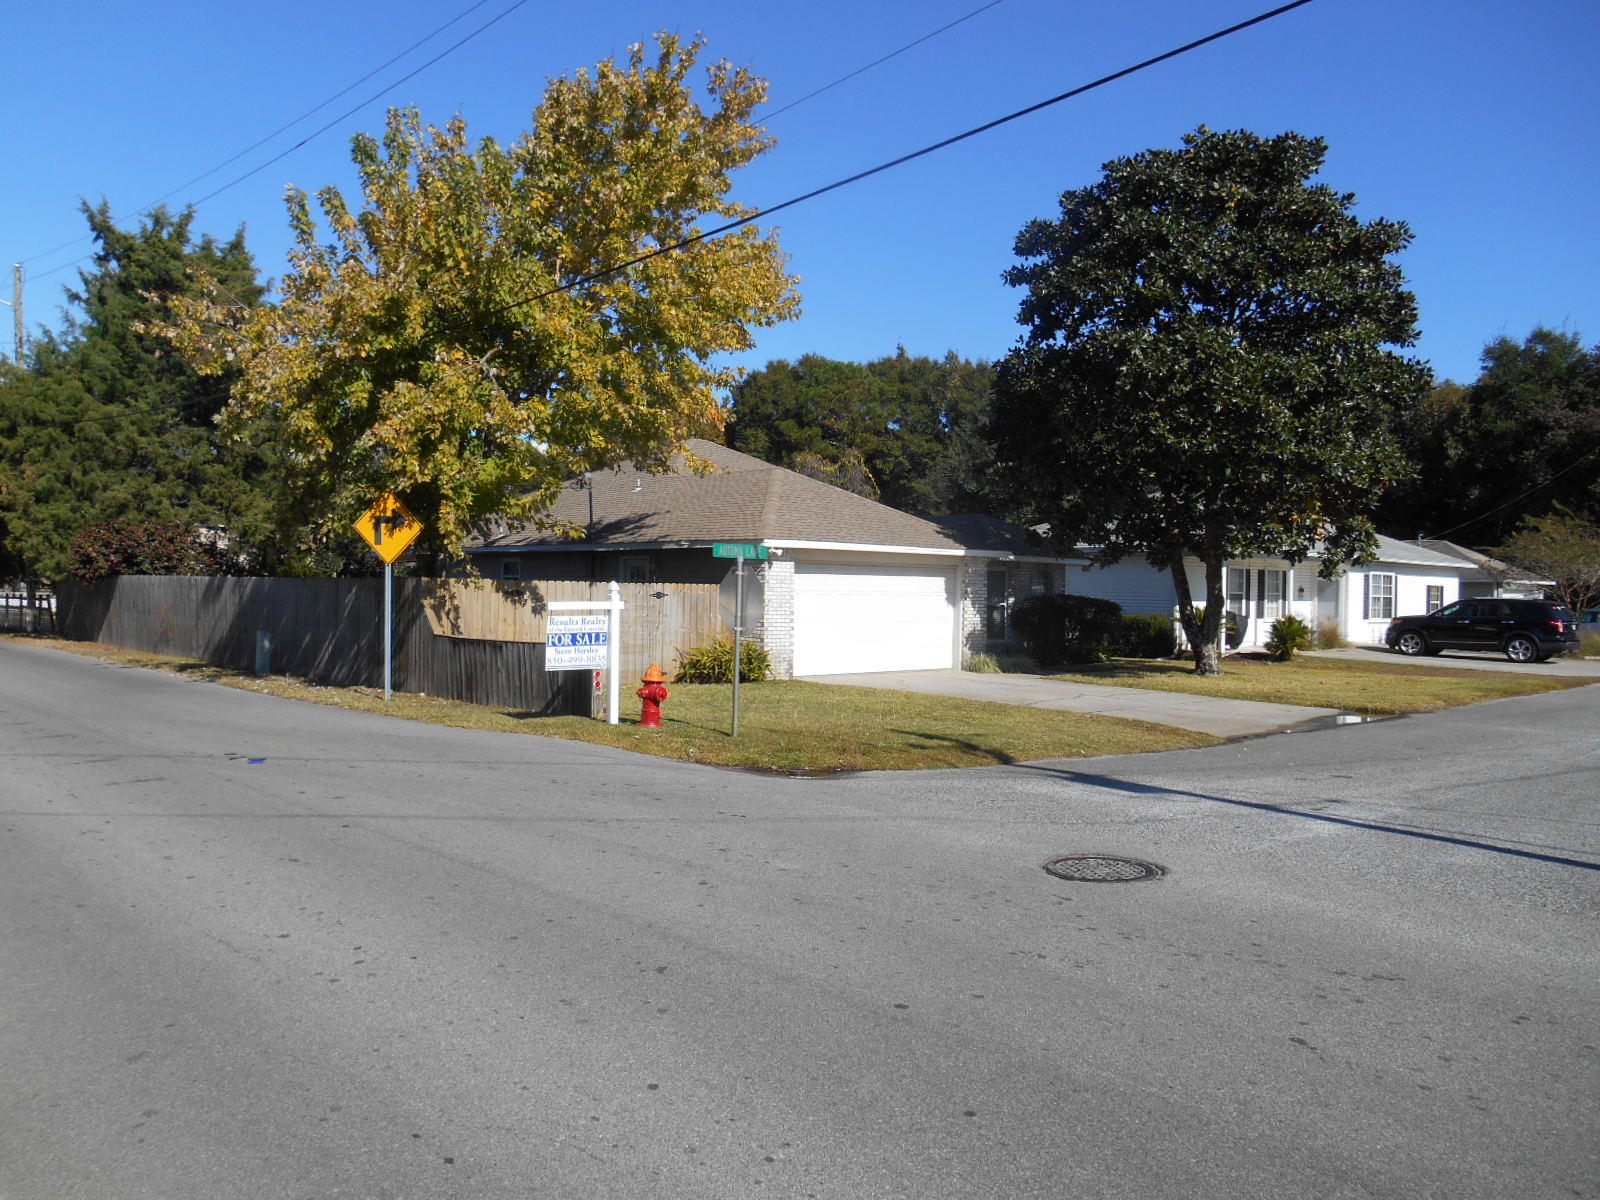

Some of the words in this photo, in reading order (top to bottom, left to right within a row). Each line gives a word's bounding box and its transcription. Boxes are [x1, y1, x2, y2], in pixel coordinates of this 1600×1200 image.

[549, 617, 579, 626] Results
[581, 616, 606, 625] Realty
[548, 633, 573, 646] FOR
[575, 632, 607, 645] SALE
[554, 647, 572, 655] Steve
